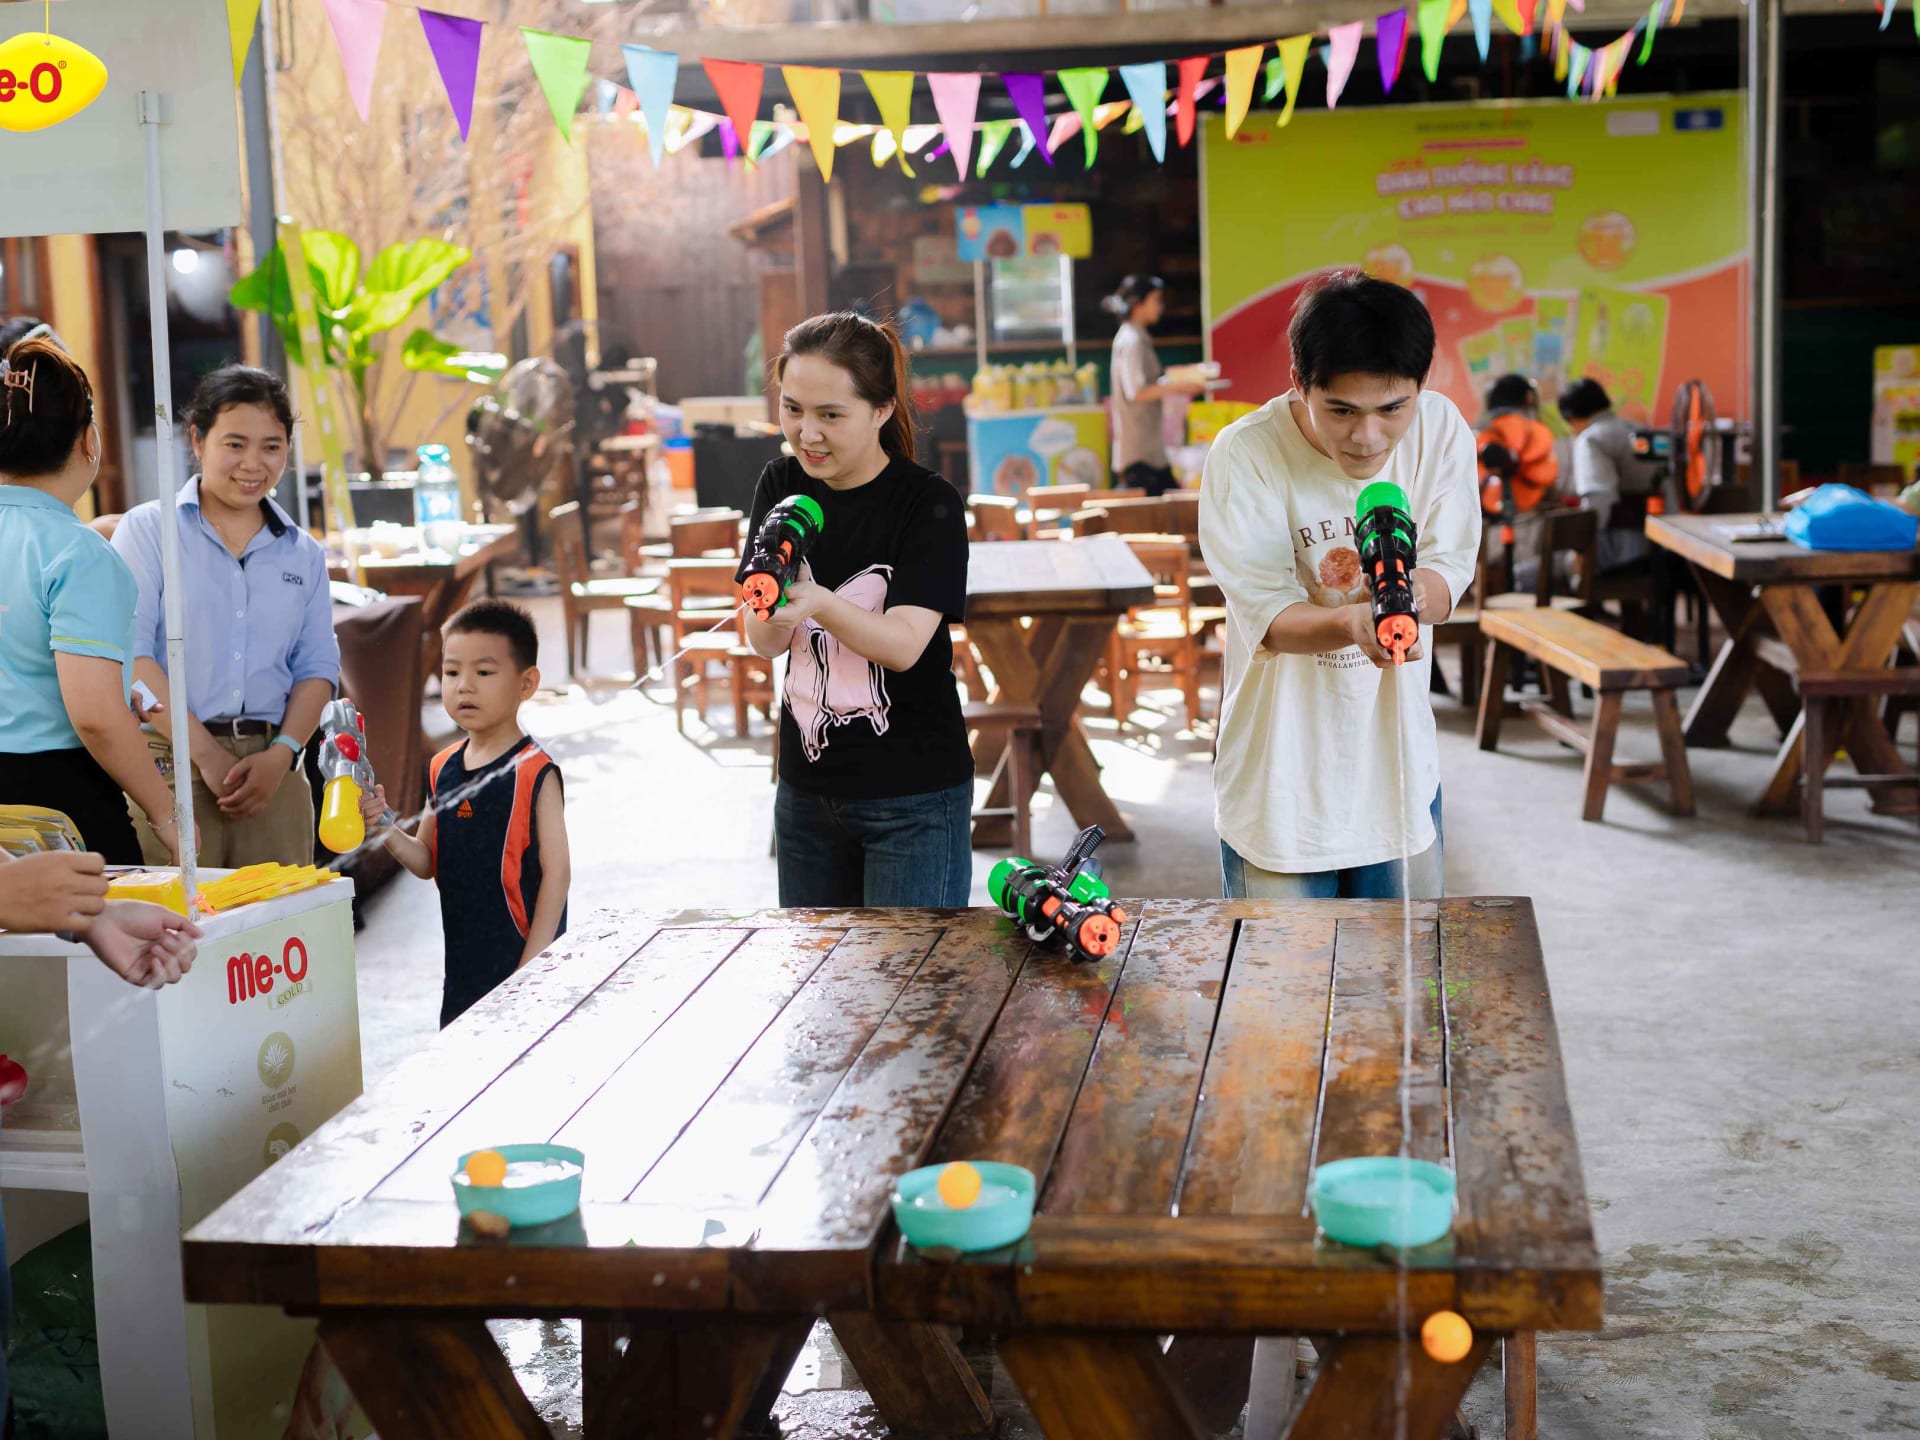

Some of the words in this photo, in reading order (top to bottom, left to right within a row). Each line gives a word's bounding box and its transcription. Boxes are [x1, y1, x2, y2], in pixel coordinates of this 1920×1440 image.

[0, 62, 62, 103] e-O
[1295, 515, 1357, 553] REN
[227, 936, 308, 1005] Me-O
[277, 983, 303, 1005] GOLD
